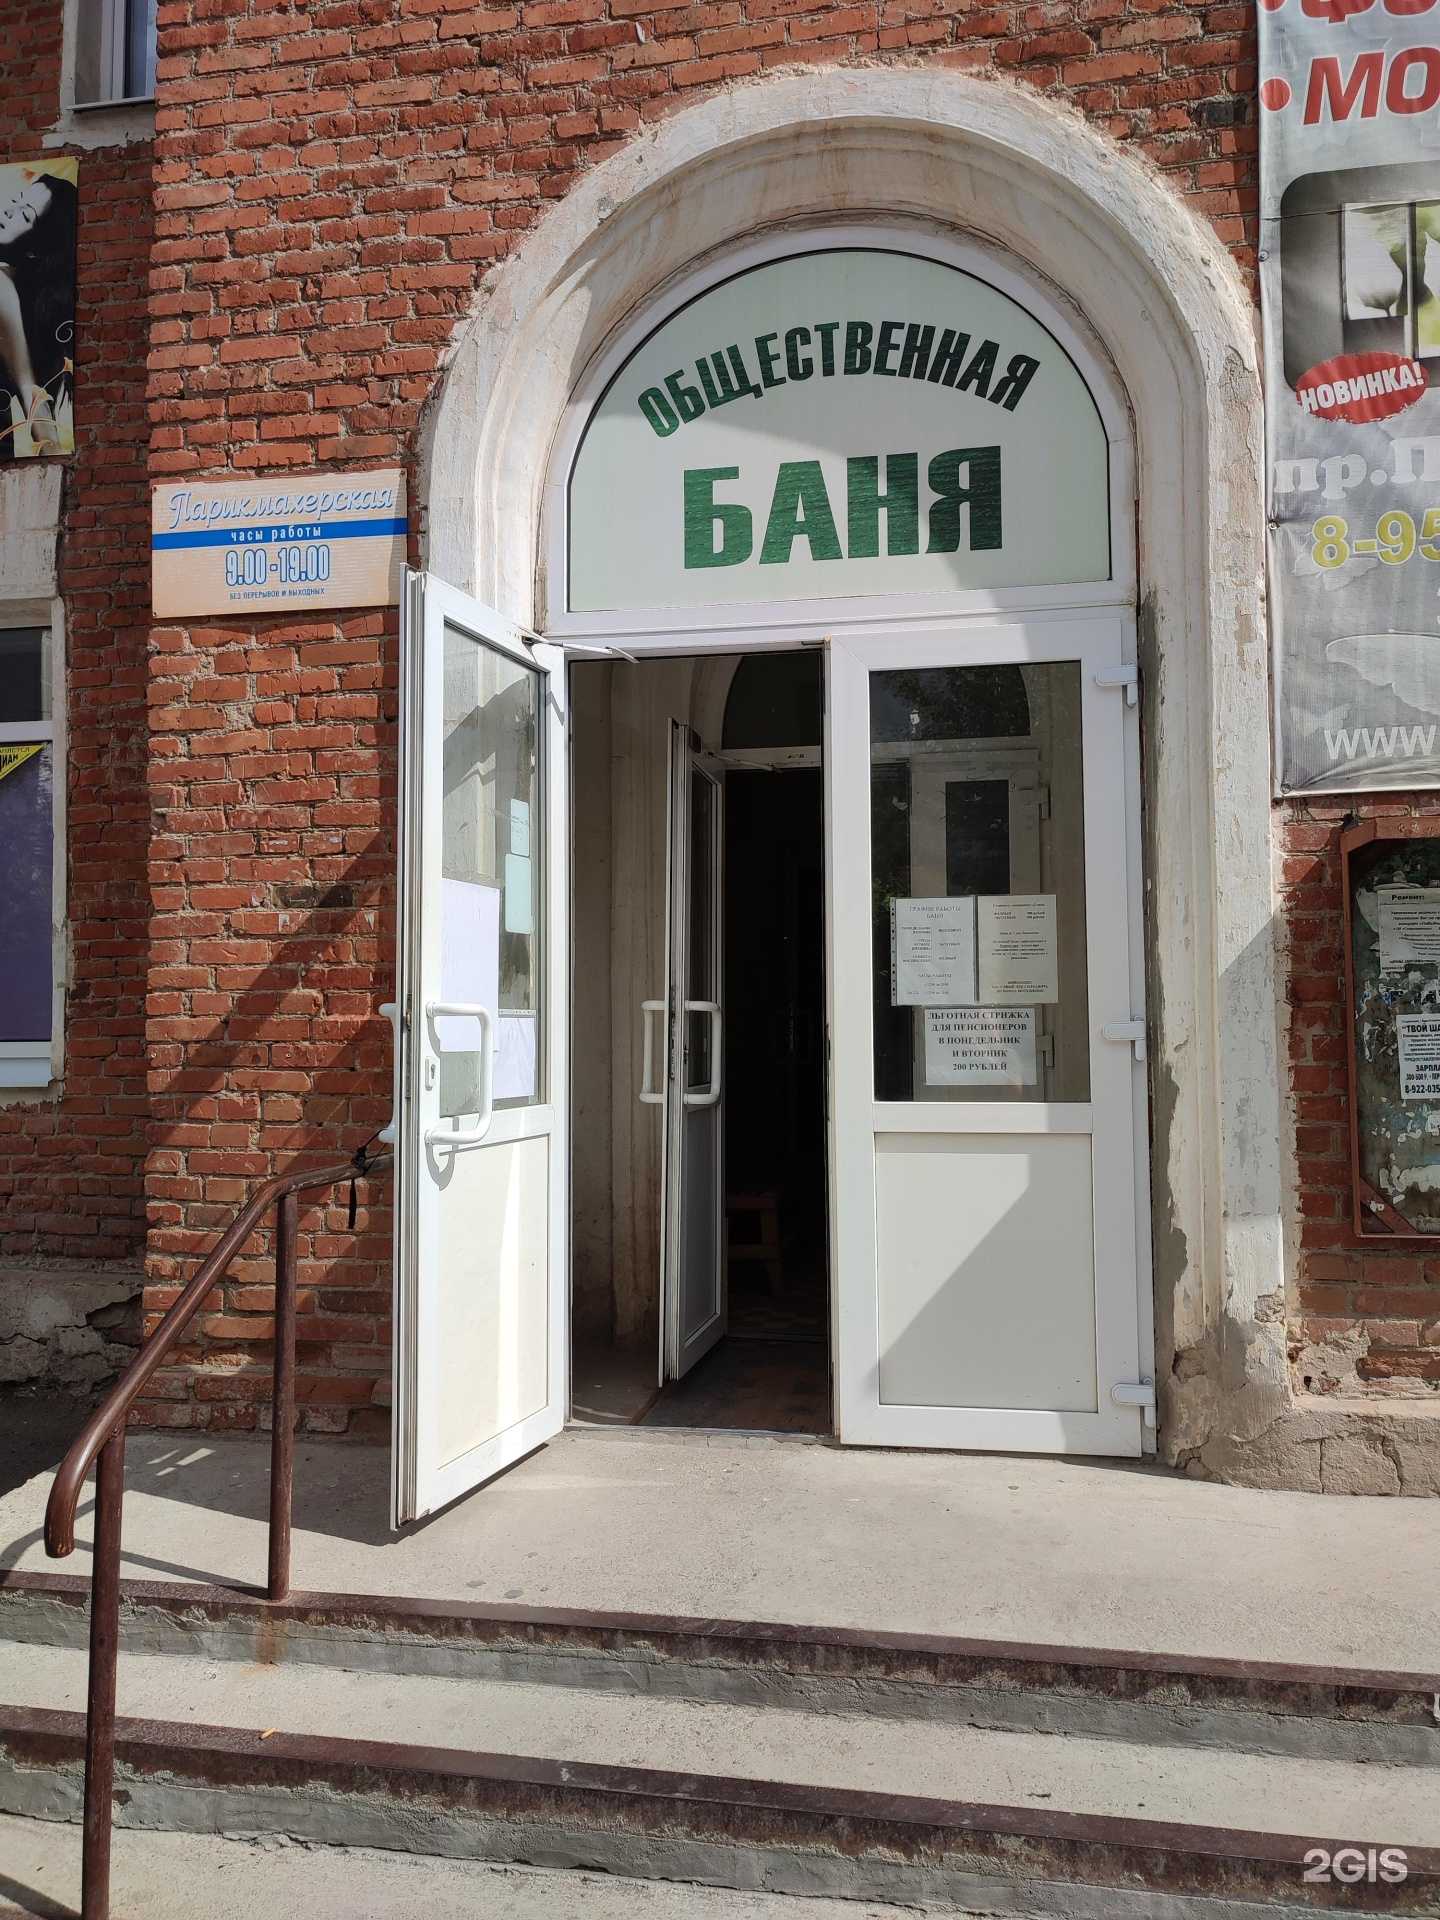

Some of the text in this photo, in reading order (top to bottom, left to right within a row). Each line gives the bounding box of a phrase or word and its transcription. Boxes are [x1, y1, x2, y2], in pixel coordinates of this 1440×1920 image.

[637, 320, 1040, 438] ОБЩЕСТВЕННАЯ
[1299, 362, 1424, 414] НОВИНКА!
[168, 486, 394, 529] Парикмахерская
[684, 445, 1002, 569] БАНЯ
[231, 525, 322, 542] часы работы
[928, 1011, 1030, 1020] ЛЬГОТНАЯ СТРИЖКА
[932, 1023, 1028, 1032] ДЛЯ ПЕНСИОНЕРОВ
[947, 1036, 1022, 1045] ПОНЕДЕЛЬНИК
[961, 1049, 1008, 1057] ВТОРНИК
[953, 1062, 1008, 1071] 200 РУБЛЕЙ
